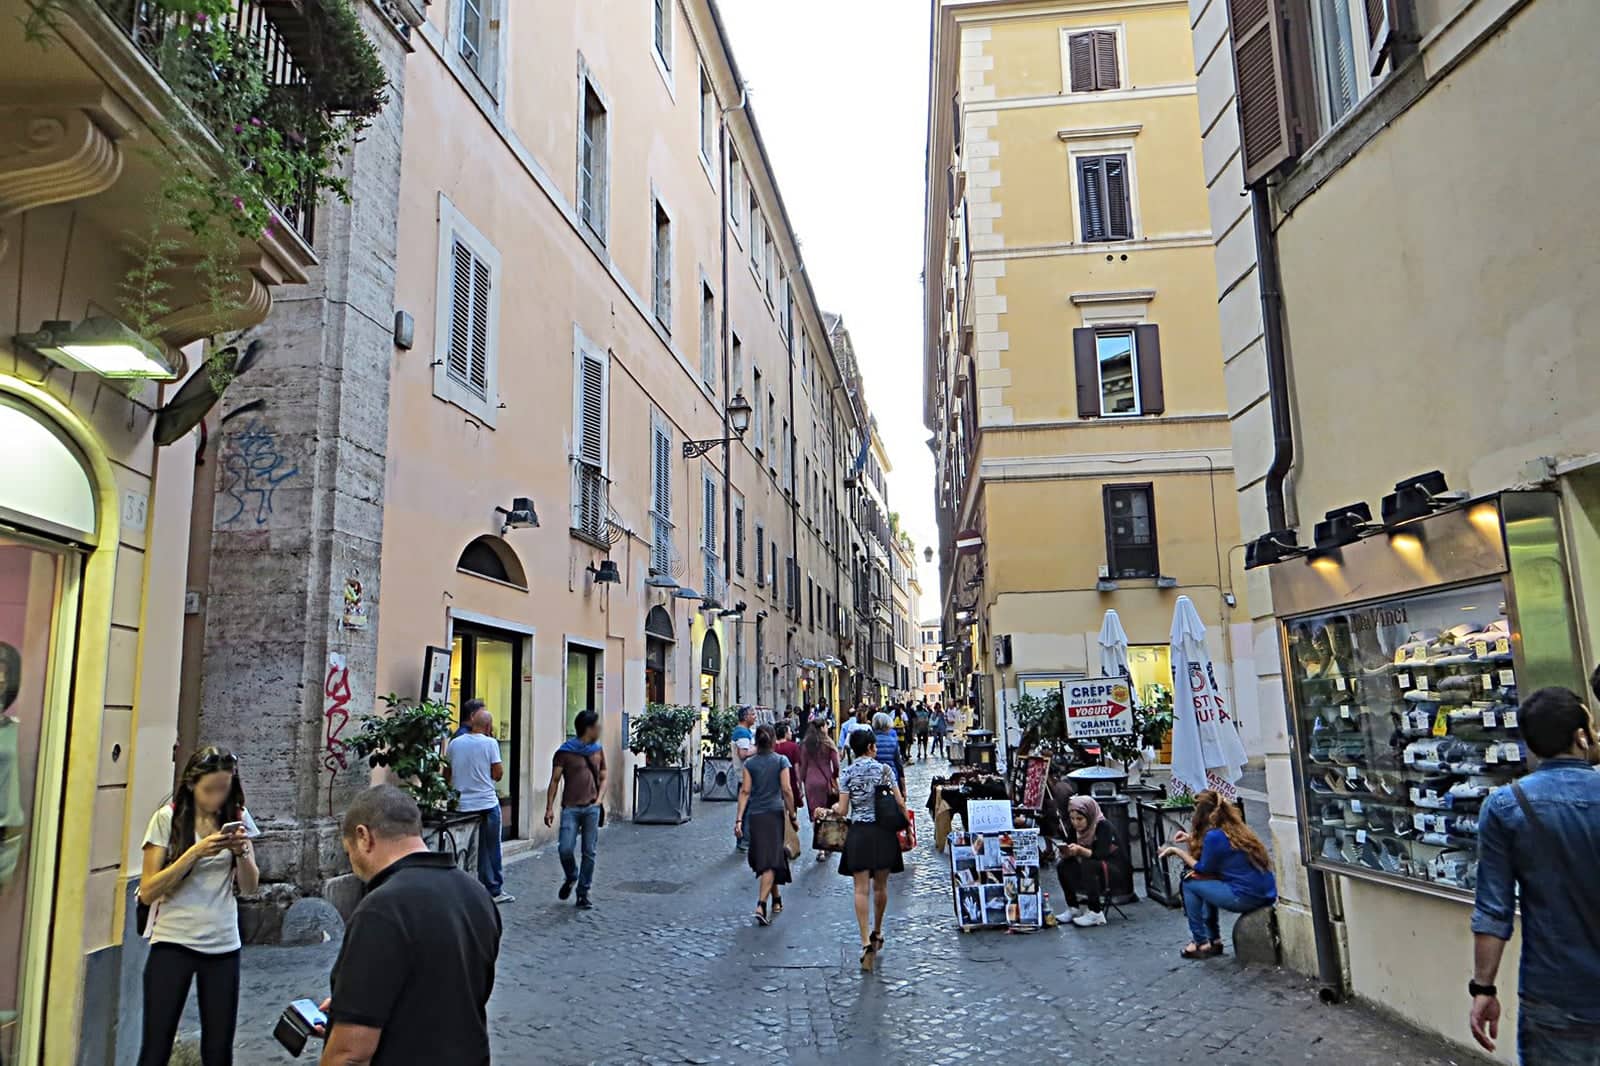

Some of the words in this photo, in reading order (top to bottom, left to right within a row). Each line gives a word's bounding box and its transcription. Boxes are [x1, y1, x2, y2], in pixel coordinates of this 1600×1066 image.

[1075, 705, 1114, 717] YOGURT
[1080, 719, 1121, 729] GRANITE
[1101, 726, 1127, 735] FRESCA
